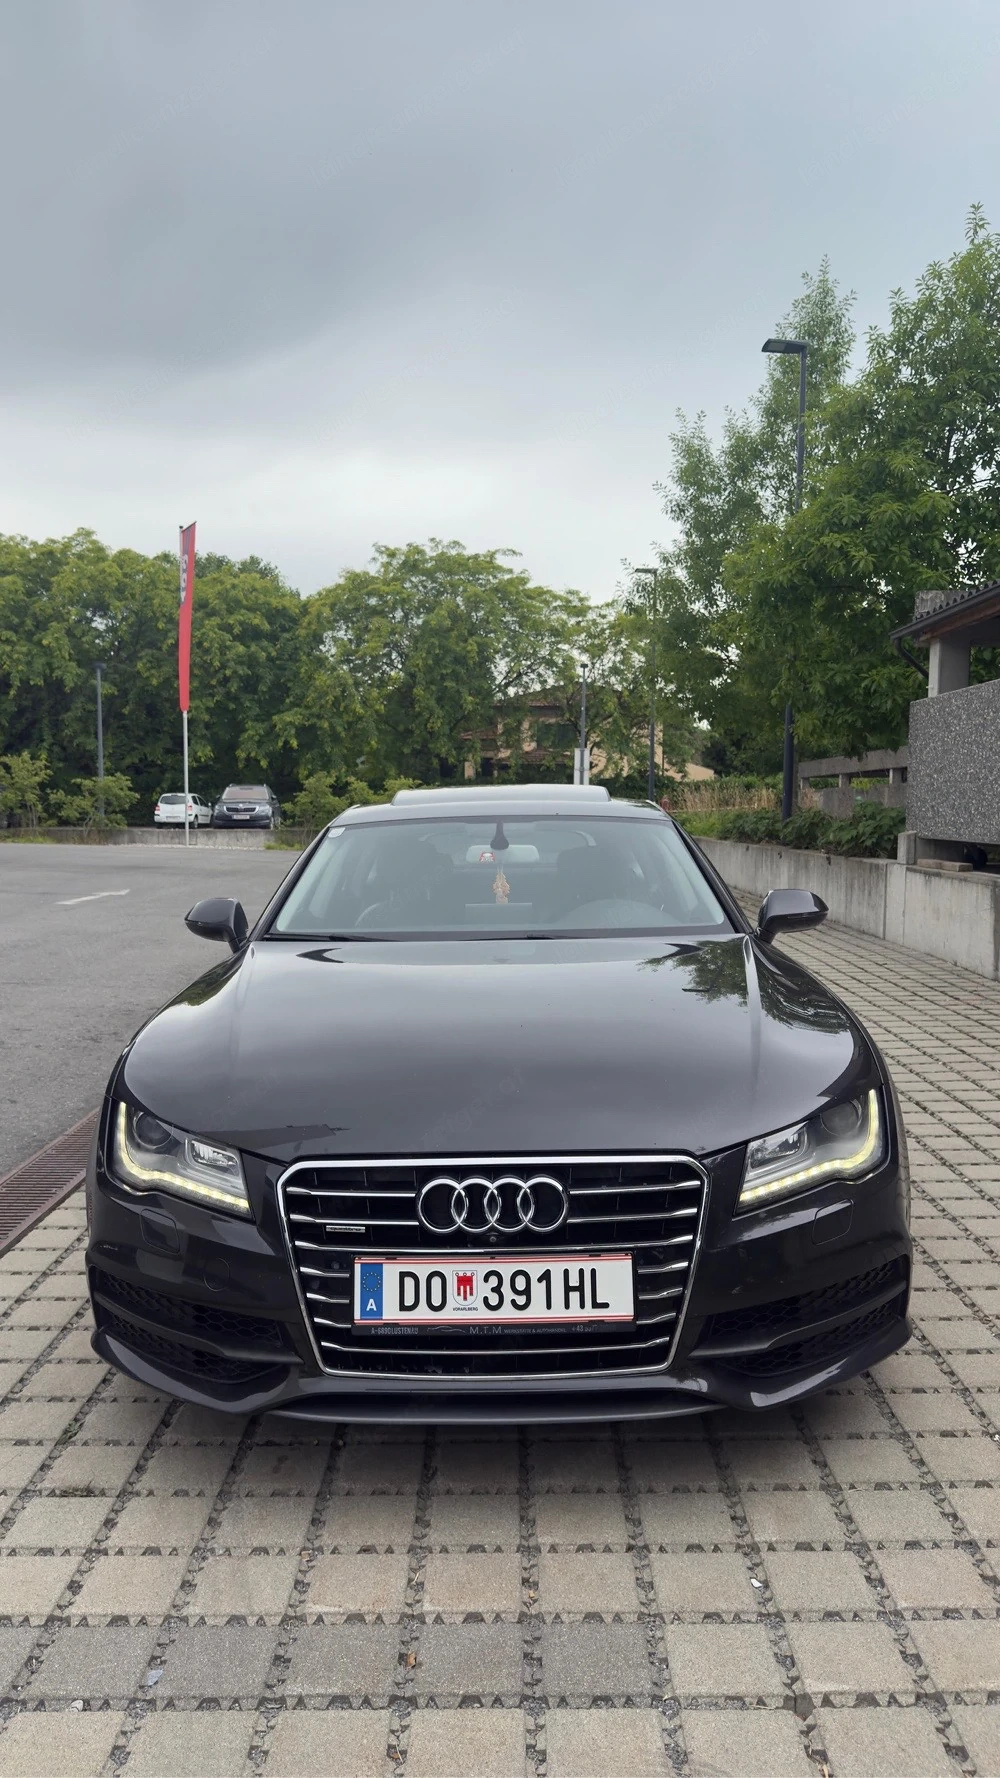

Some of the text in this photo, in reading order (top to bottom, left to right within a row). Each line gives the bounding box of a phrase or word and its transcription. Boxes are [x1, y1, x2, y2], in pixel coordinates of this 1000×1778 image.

[365, 1298, 378, 1312] A
[398, 1267, 611, 1313] DO 391HL
